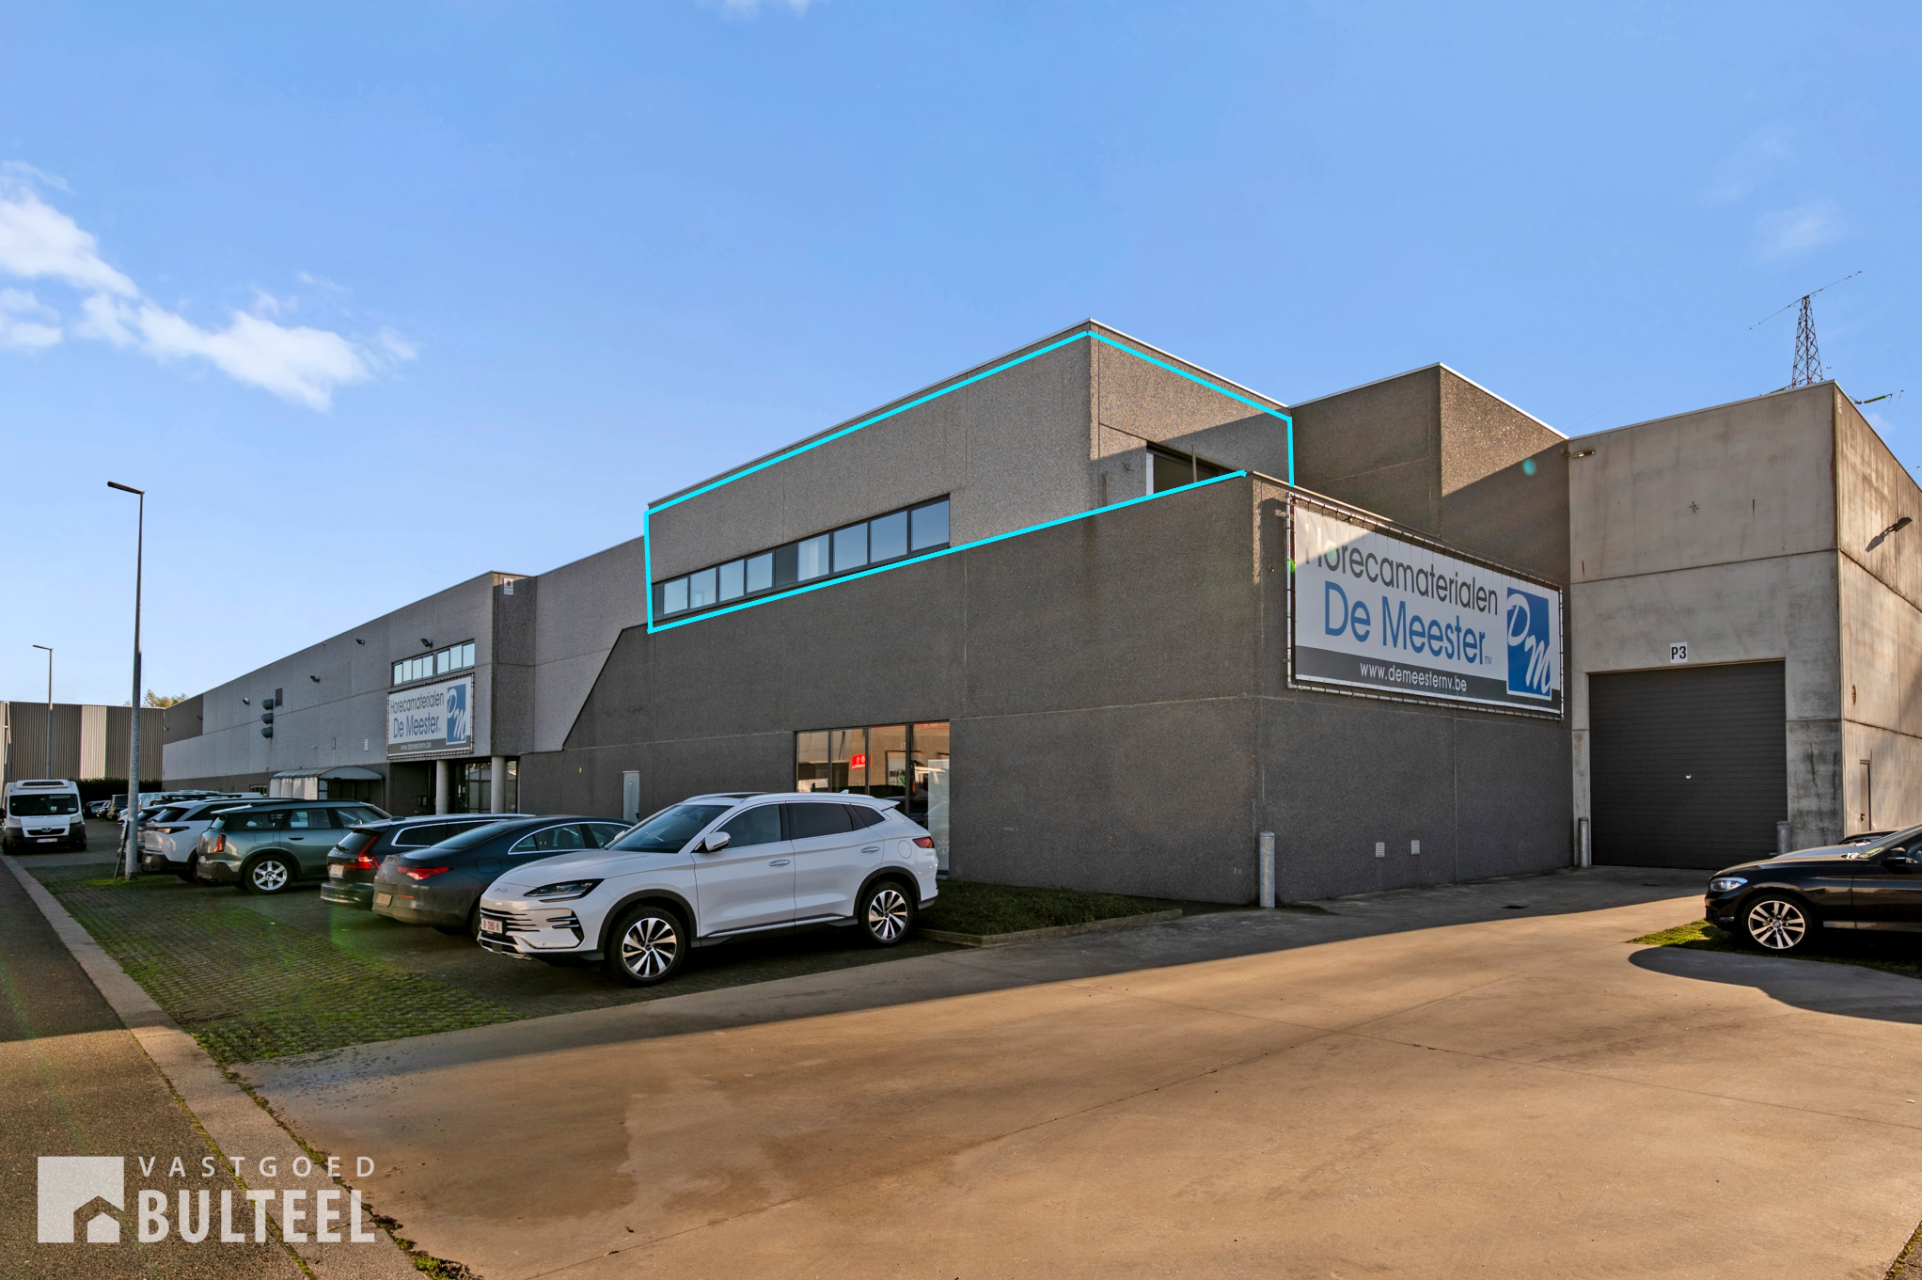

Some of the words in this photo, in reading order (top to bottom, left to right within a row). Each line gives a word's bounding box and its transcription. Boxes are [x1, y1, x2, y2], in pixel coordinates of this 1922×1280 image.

[1305, 523, 1498, 616] Horecamaterialen
[1325, 580, 1371, 642] De
[1382, 595, 1485, 665] Meester
[1671, 646, 1686, 660] P3
[1360, 662, 1467, 691] www.demeesternv.be
[393, 717, 404, 738] De
[406, 712, 439, 737] Meester
